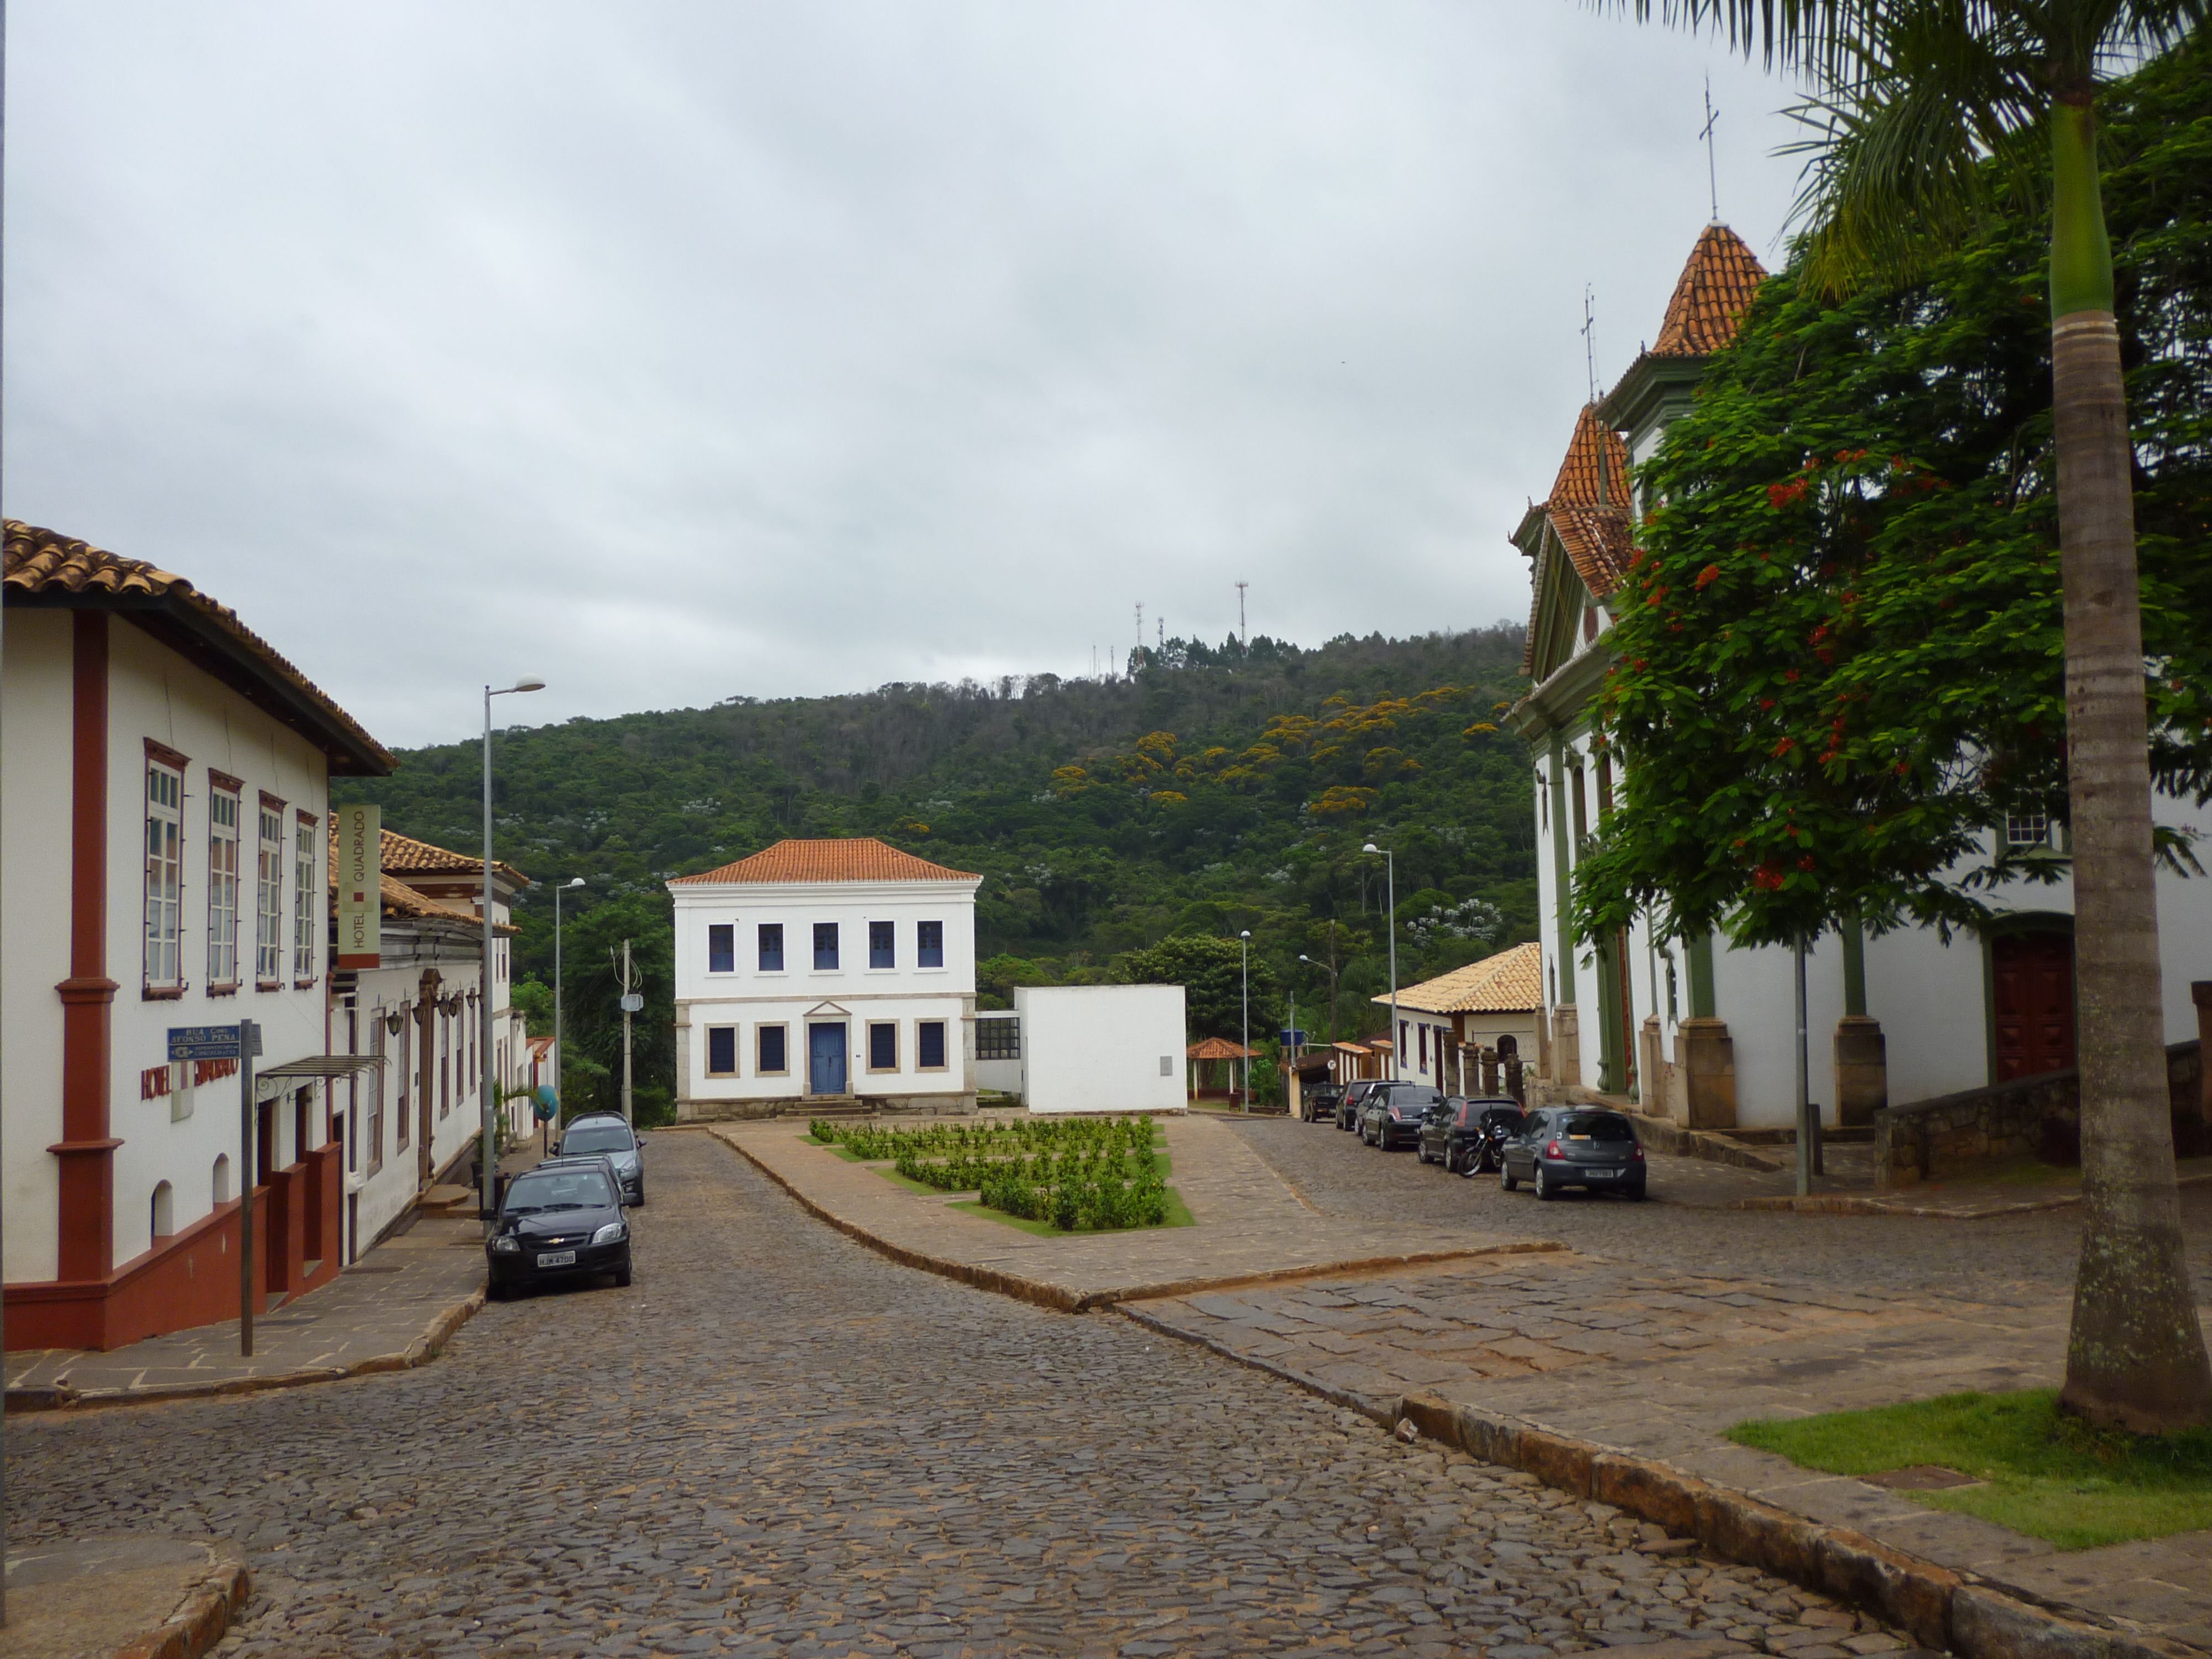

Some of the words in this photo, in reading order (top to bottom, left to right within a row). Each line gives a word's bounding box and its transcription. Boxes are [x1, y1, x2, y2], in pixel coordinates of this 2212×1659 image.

[353, 811, 364, 882] QUADRADO
[353, 912, 364, 948] HOTEL
[141, 1065, 172, 1100] HOTEL
